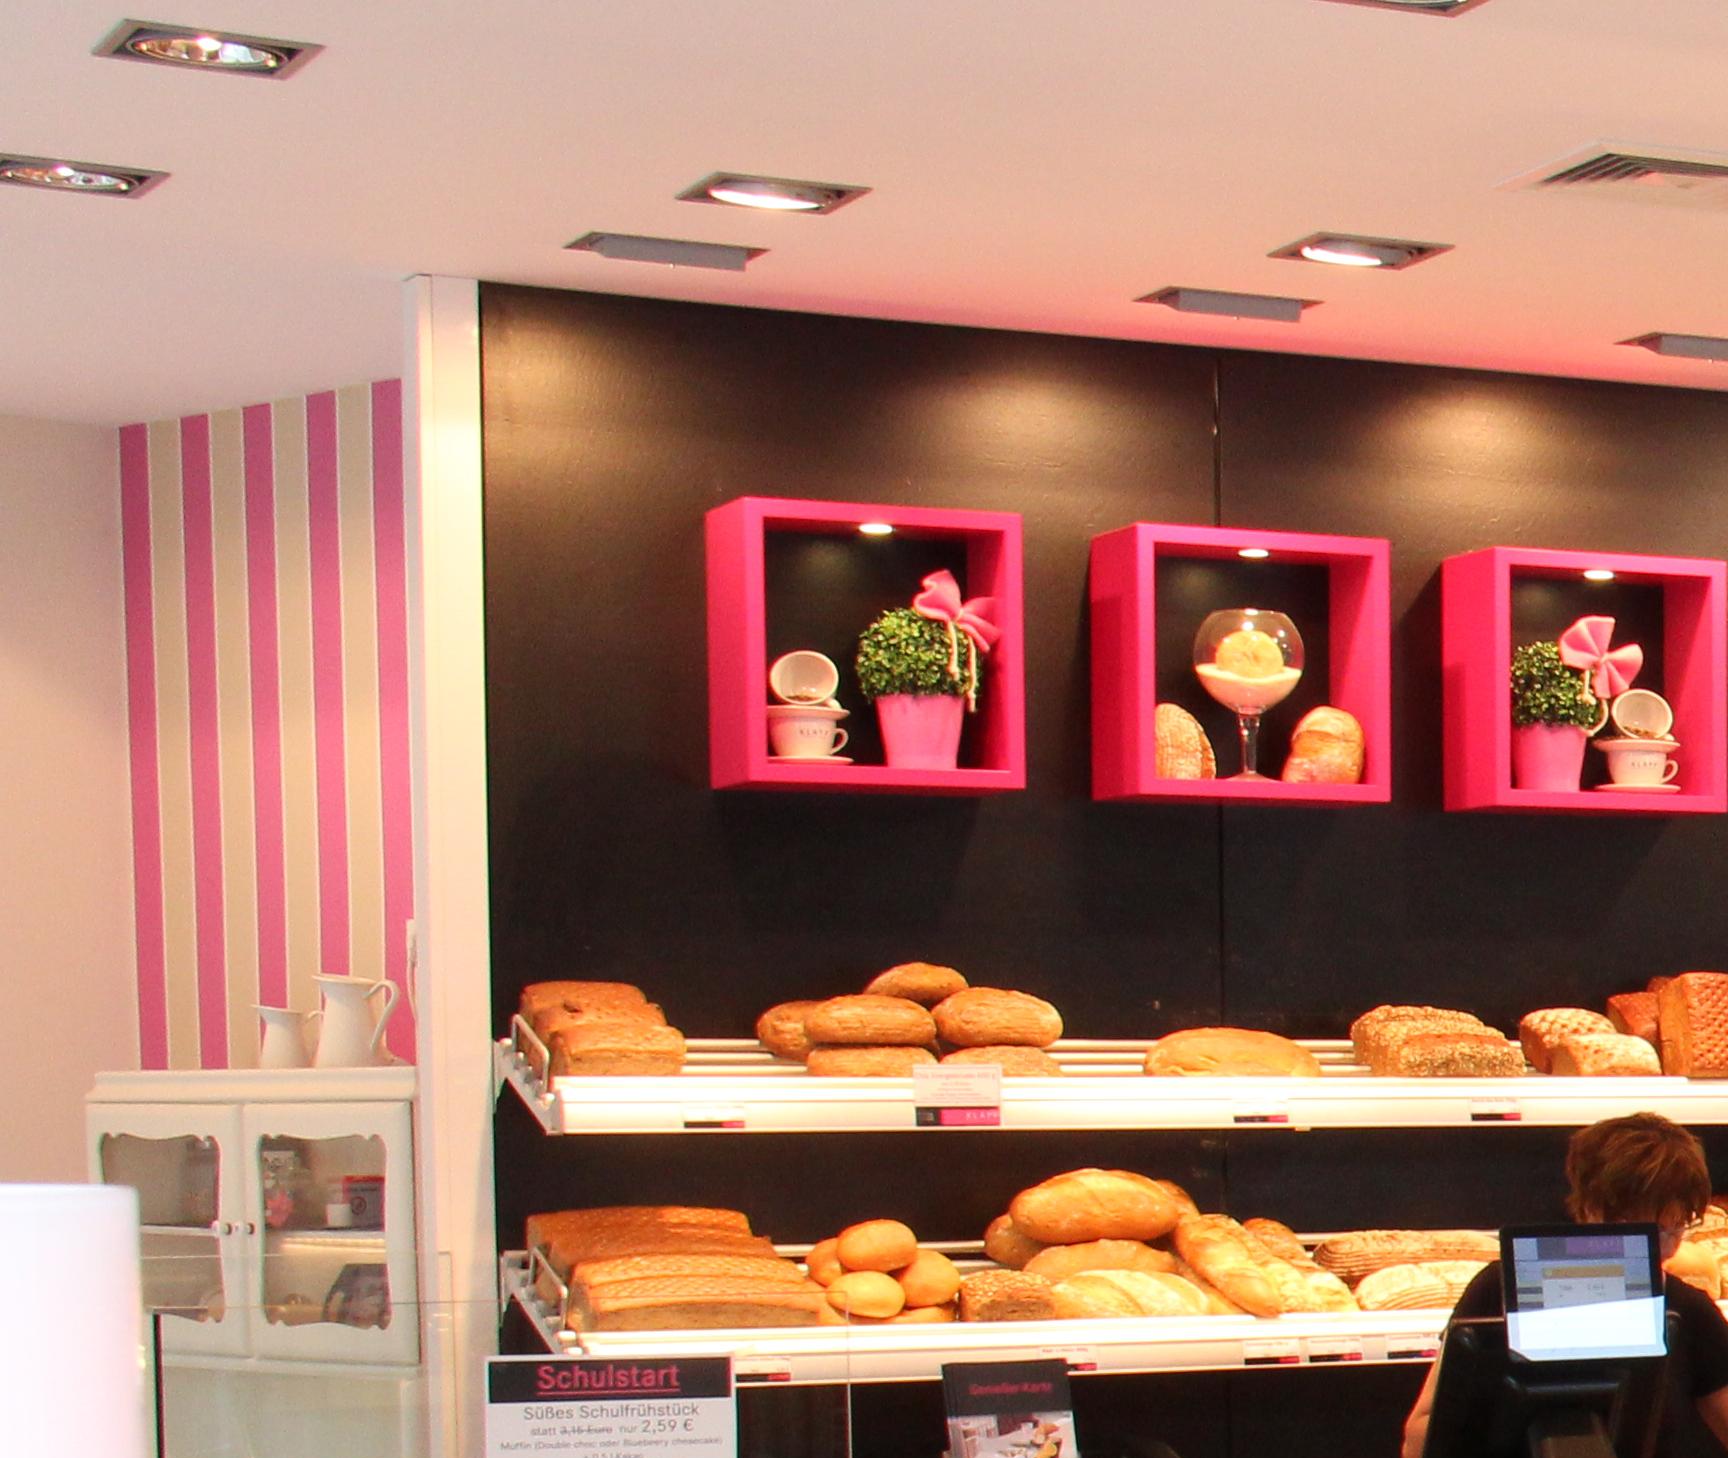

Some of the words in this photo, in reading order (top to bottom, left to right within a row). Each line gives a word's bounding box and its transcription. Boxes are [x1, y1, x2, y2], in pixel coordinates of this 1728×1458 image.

[536, 1364, 681, 1390] Schulstart
[523, 1406, 574, 1421] Süßes
[579, 1402, 700, 1419] Schulfrühstück
[619, 1424, 638, 1434] nur
[641, 1419, 677, 1435] 2,59
[683, 1418, 693, 1432] €
